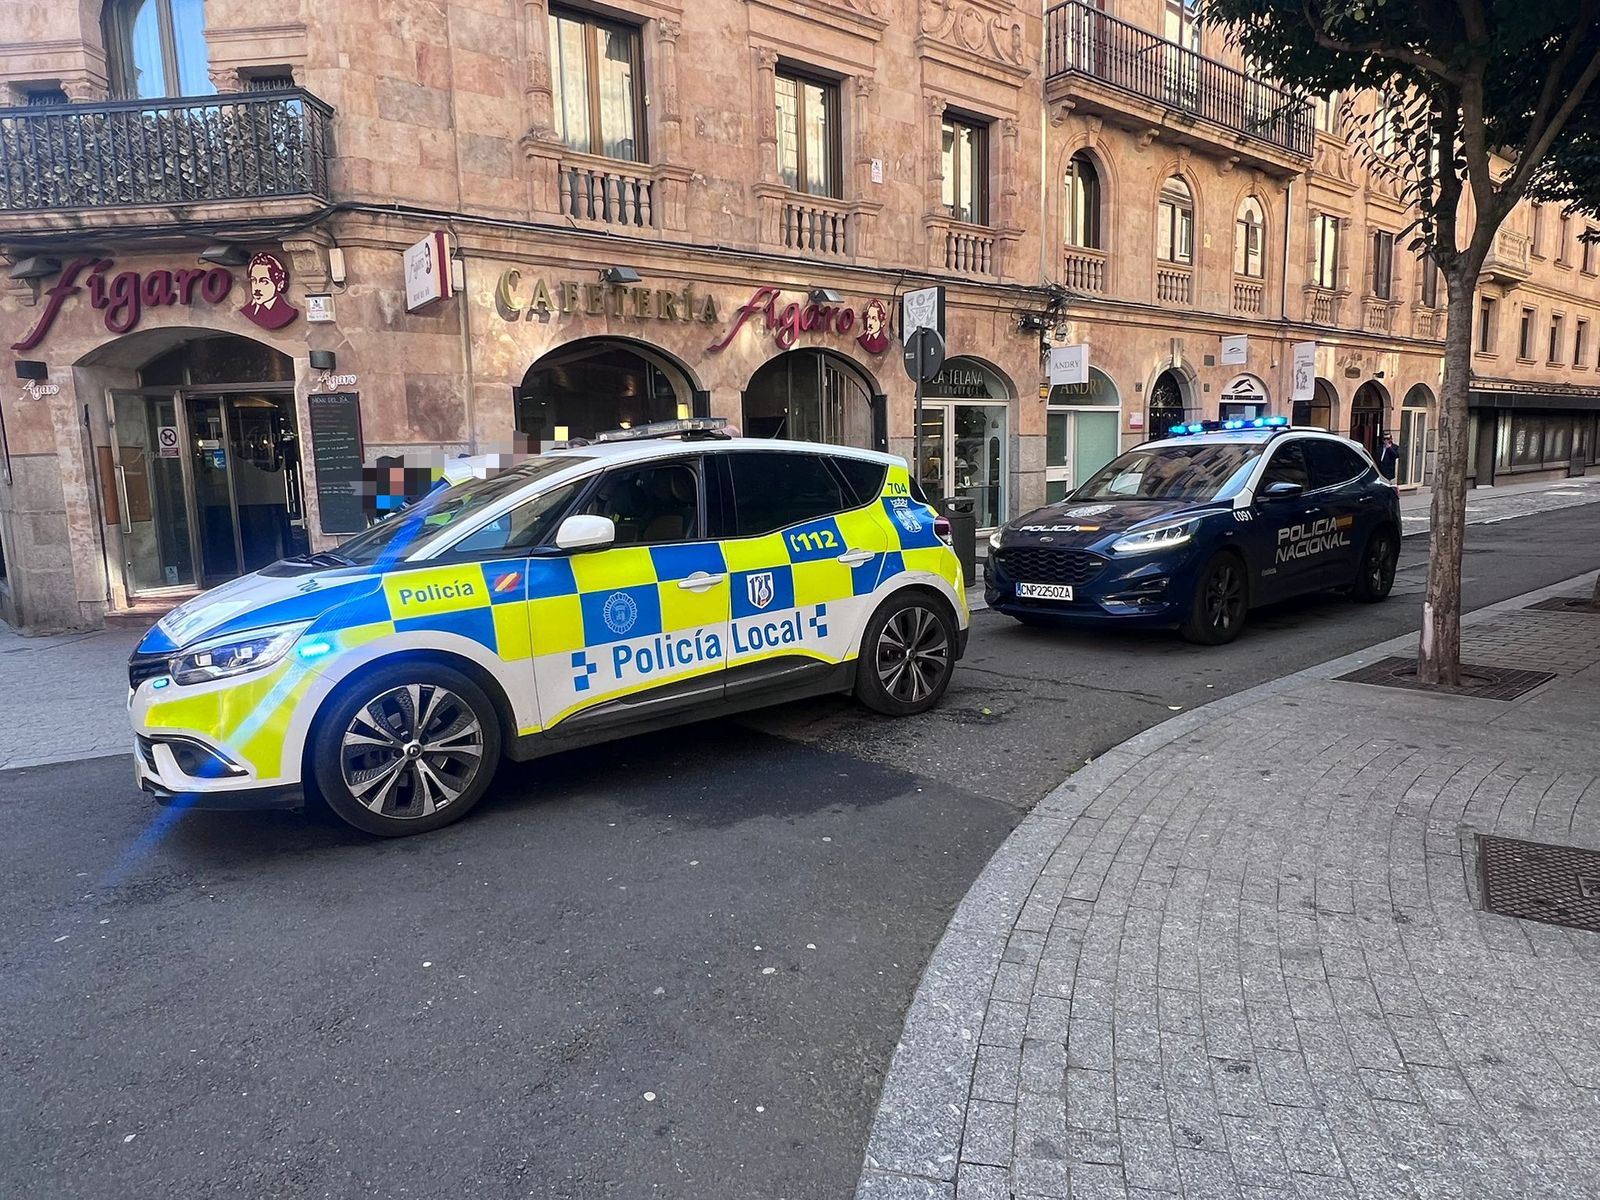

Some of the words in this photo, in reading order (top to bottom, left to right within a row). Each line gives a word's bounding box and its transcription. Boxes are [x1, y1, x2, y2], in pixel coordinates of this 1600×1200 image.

[1053, 360, 1080, 370] ANDRY
[887, 482, 907, 495] 704
[1239, 510, 1253, 521] 091
[797, 530, 838, 551] 112
[1277, 516, 1337, 545] POLICIA
[1275, 531, 1351, 564] NACIONAL
[399, 579, 475, 605] Policía
[612, 628, 722, 679] Policía
[731, 611, 803, 653] Local
